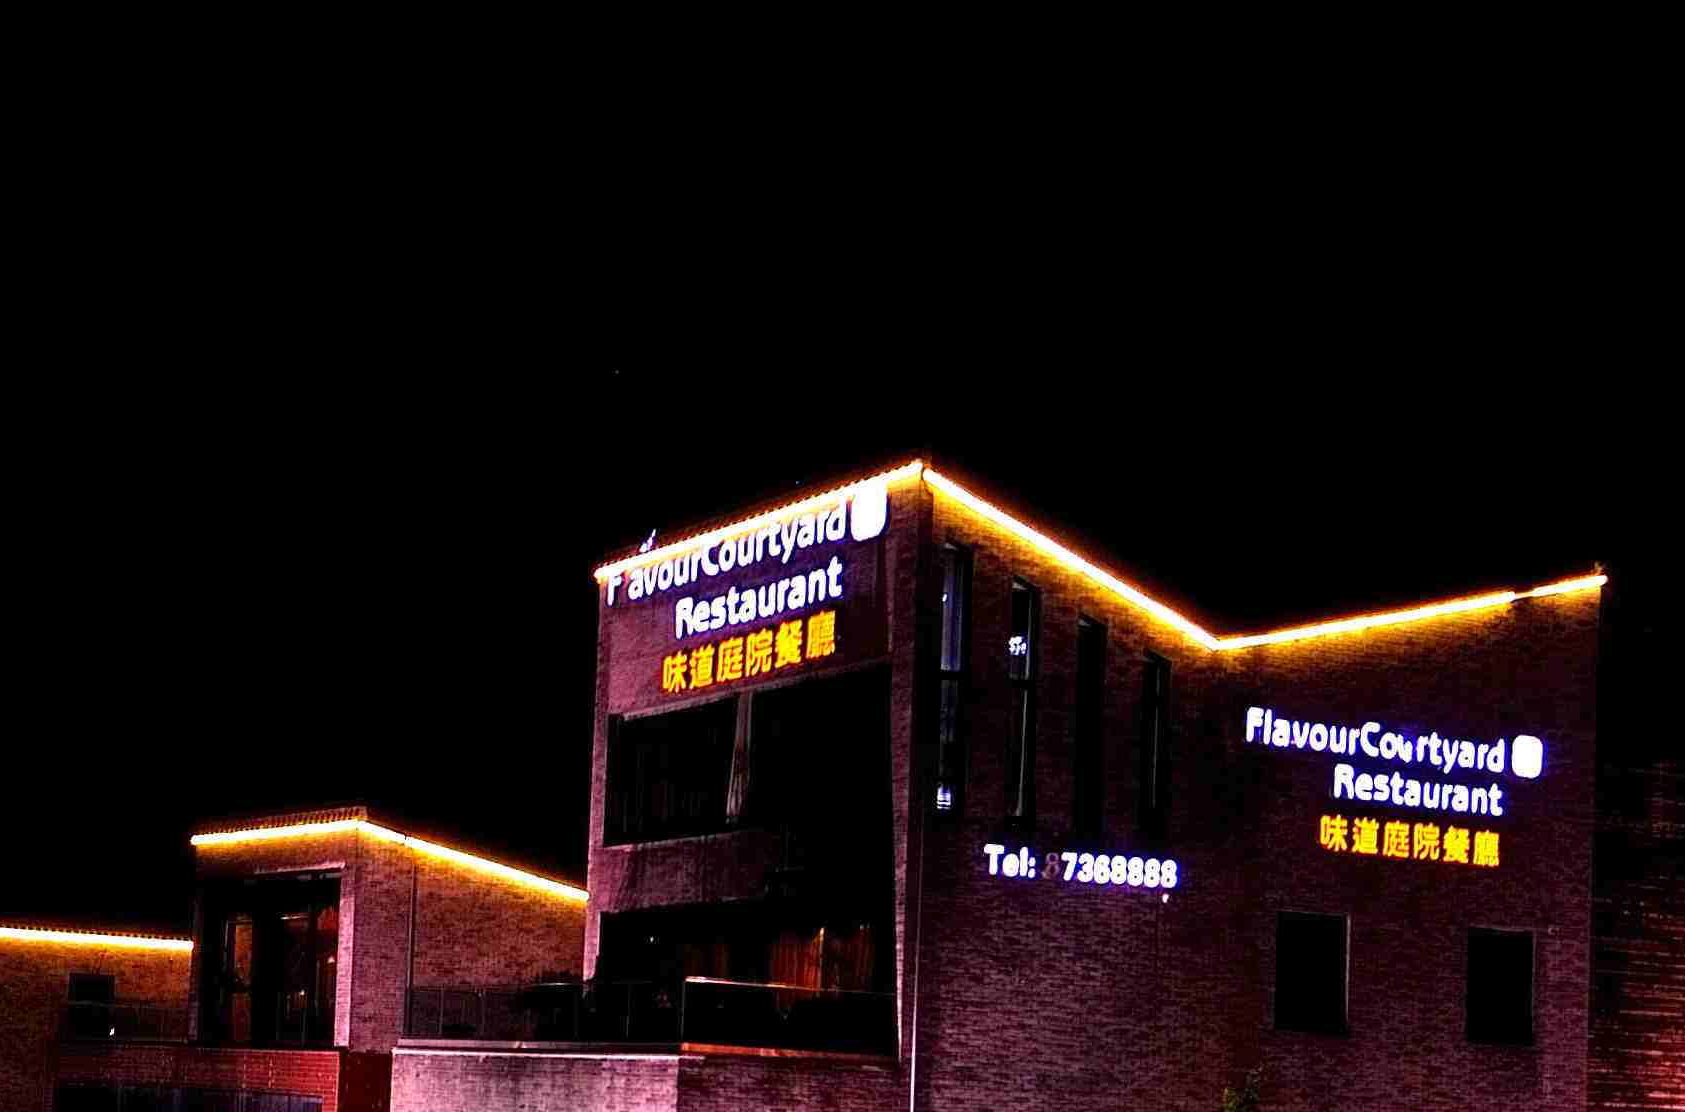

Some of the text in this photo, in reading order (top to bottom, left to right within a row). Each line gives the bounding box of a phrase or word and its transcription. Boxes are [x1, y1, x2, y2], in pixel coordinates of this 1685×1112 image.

[607, 500, 847, 606] FavourCourtyard
[676, 556, 842, 639] Restaurant
[663, 611, 836, 692] 味道庭院餐廳
[1246, 707, 1505, 773] FlavourCourtyard
[1334, 763, 1503, 816] Restaurant
[984, 844, 1036, 878] Tel:
[1320, 815, 1500, 866] 味道庭院餐廳
